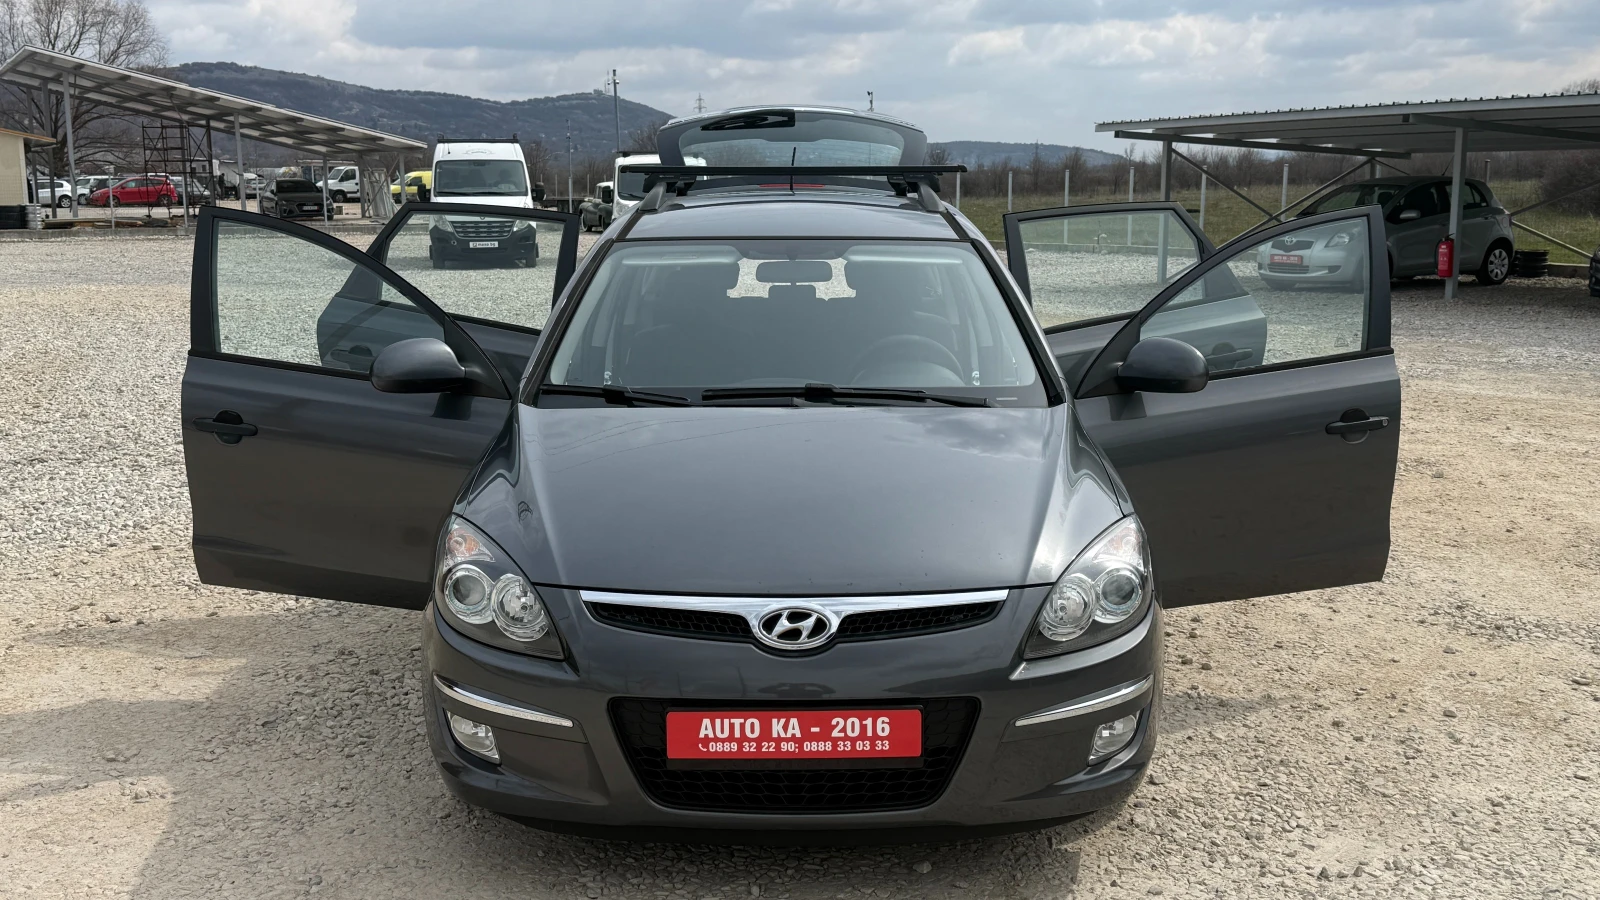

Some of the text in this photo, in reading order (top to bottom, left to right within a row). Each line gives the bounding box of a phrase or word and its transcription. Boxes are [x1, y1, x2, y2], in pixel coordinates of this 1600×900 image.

[698, 717, 761, 739] AUTO
[771, 717, 802, 739] KA
[831, 716, 891, 738] 2016
[708, 740, 890, 754] 0889 32 22 90; 0888 33 03 33
